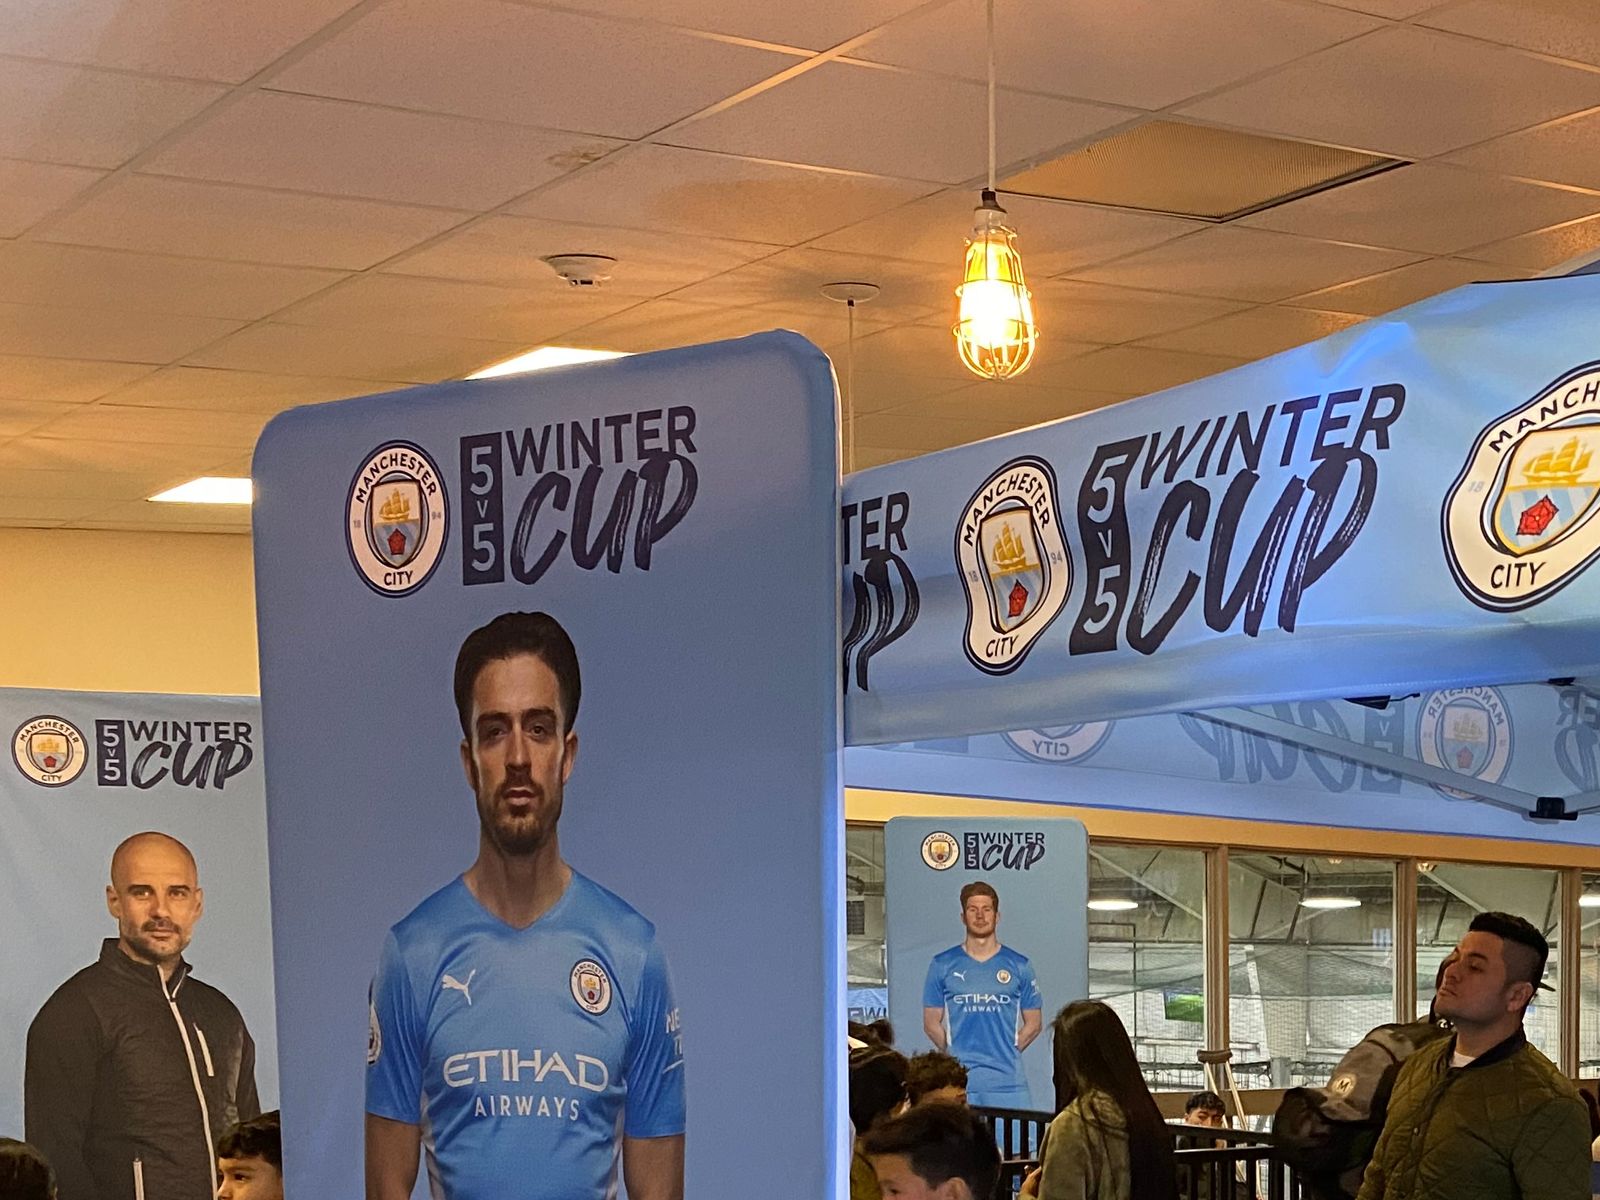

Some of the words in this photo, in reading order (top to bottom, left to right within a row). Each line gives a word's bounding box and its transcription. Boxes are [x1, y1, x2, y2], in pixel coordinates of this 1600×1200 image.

[506, 405, 697, 477] WINTER
[1140, 383, 1406, 490] WINTER
[356, 453, 437, 504] MANCHESTER
[1467, 479, 1485, 495] 18
[510, 451, 698, 585] CUP
[962, 469, 1052, 548] MANCHESTER
[842, 491, 910, 565] TER
[1126, 447, 1379, 656] CUP
[384, 570, 413, 587] CITY
[1489, 559, 1548, 590] CITY
[984, 634, 1020, 659] CITY
[20, 721, 79, 744] MANCHESTER
[127, 721, 252, 743] WINTER
[41, 773, 63, 783] CITY
[131, 738, 253, 790] CUP
[981, 832, 1045, 845] WINTER
[982, 842, 1045, 871] CUP
[953, 993, 1011, 1004] ETIHAD
[443, 1048, 609, 1092] ETIHAD
[474, 1095, 579, 1121] AIRWAYS
